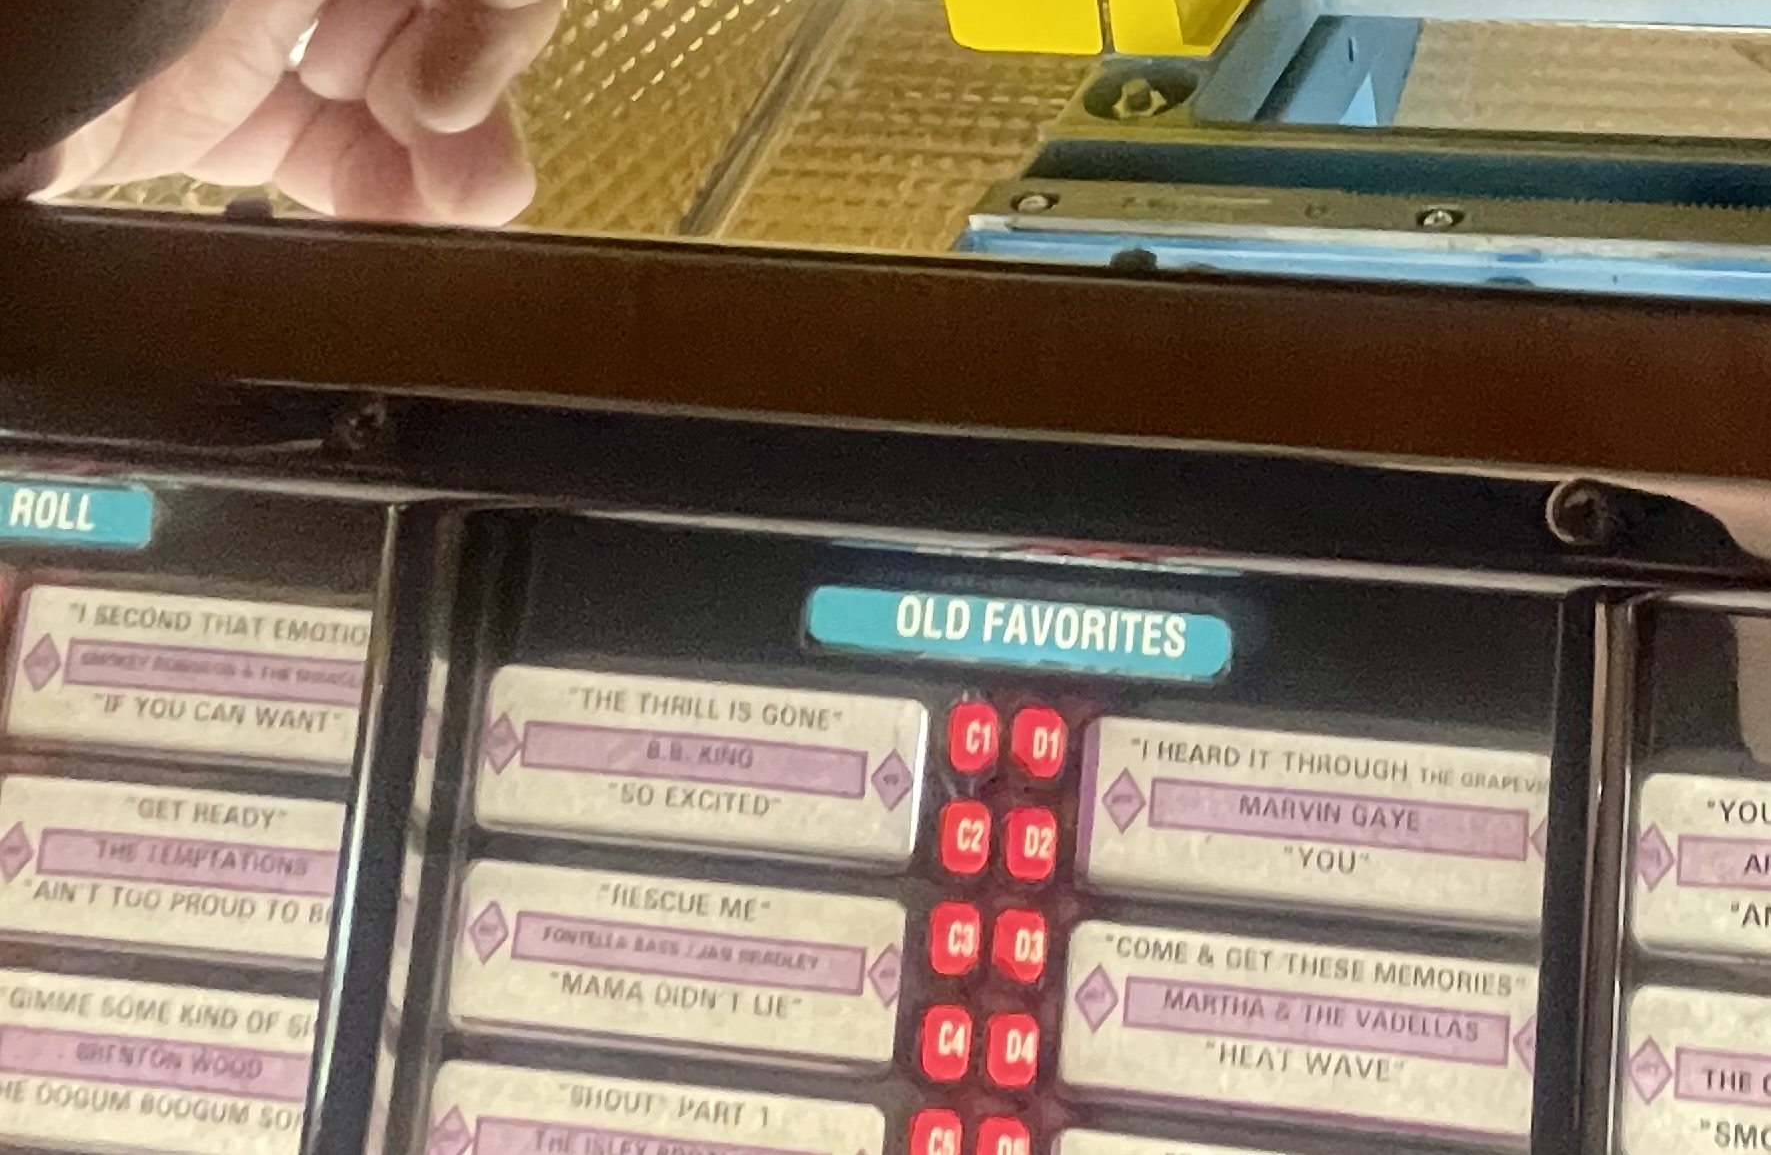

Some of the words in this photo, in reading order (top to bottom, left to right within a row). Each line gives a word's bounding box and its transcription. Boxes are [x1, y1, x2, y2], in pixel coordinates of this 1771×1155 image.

[10, 489, 95, 531] ROLL
[94, 605, 191, 631] SECOND
[200, 612, 266, 637] THAT
[896, 594, 970, 640] OLD
[983, 601, 1187, 658] FAVORITES
[136, 696, 186, 719] YOU
[193, 701, 244, 726] CAN
[638, 693, 720, 720] THRILL
[728, 701, 752, 722] IS
[966, 719, 992, 754] C1
[1032, 727, 1061, 760] D1
[1157, 741, 1240, 768] HEARD
[1248, 748, 1270, 771] IT
[1282, 750, 1408, 783] THROUGH
[1238, 795, 1342, 825] MARVIN
[1351, 805, 1421, 832] GAYE
[957, 817, 984, 853] C2
[1024, 825, 1052, 859] D2
[1284, 845, 1370, 874] "YOU"
[170, 891, 255, 920] PROUD
[267, 900, 299, 924] TO
[948, 921, 976, 957] C3
[1014, 928, 1044, 964] D3
[1226, 947, 1271, 971] GET
[1285, 952, 1364, 982] THESE
[100, 994, 169, 1023] SOME
[179, 1004, 238, 1029] KIND
[246, 1009, 280, 1034] OF
[1163, 987, 1266, 1020] MARTHA
[1302, 1003, 1345, 1027] THE
[938, 1020, 966, 1058] C4
[1005, 1029, 1036, 1064] D4
[1701, 1067, 1753, 1095] THE
